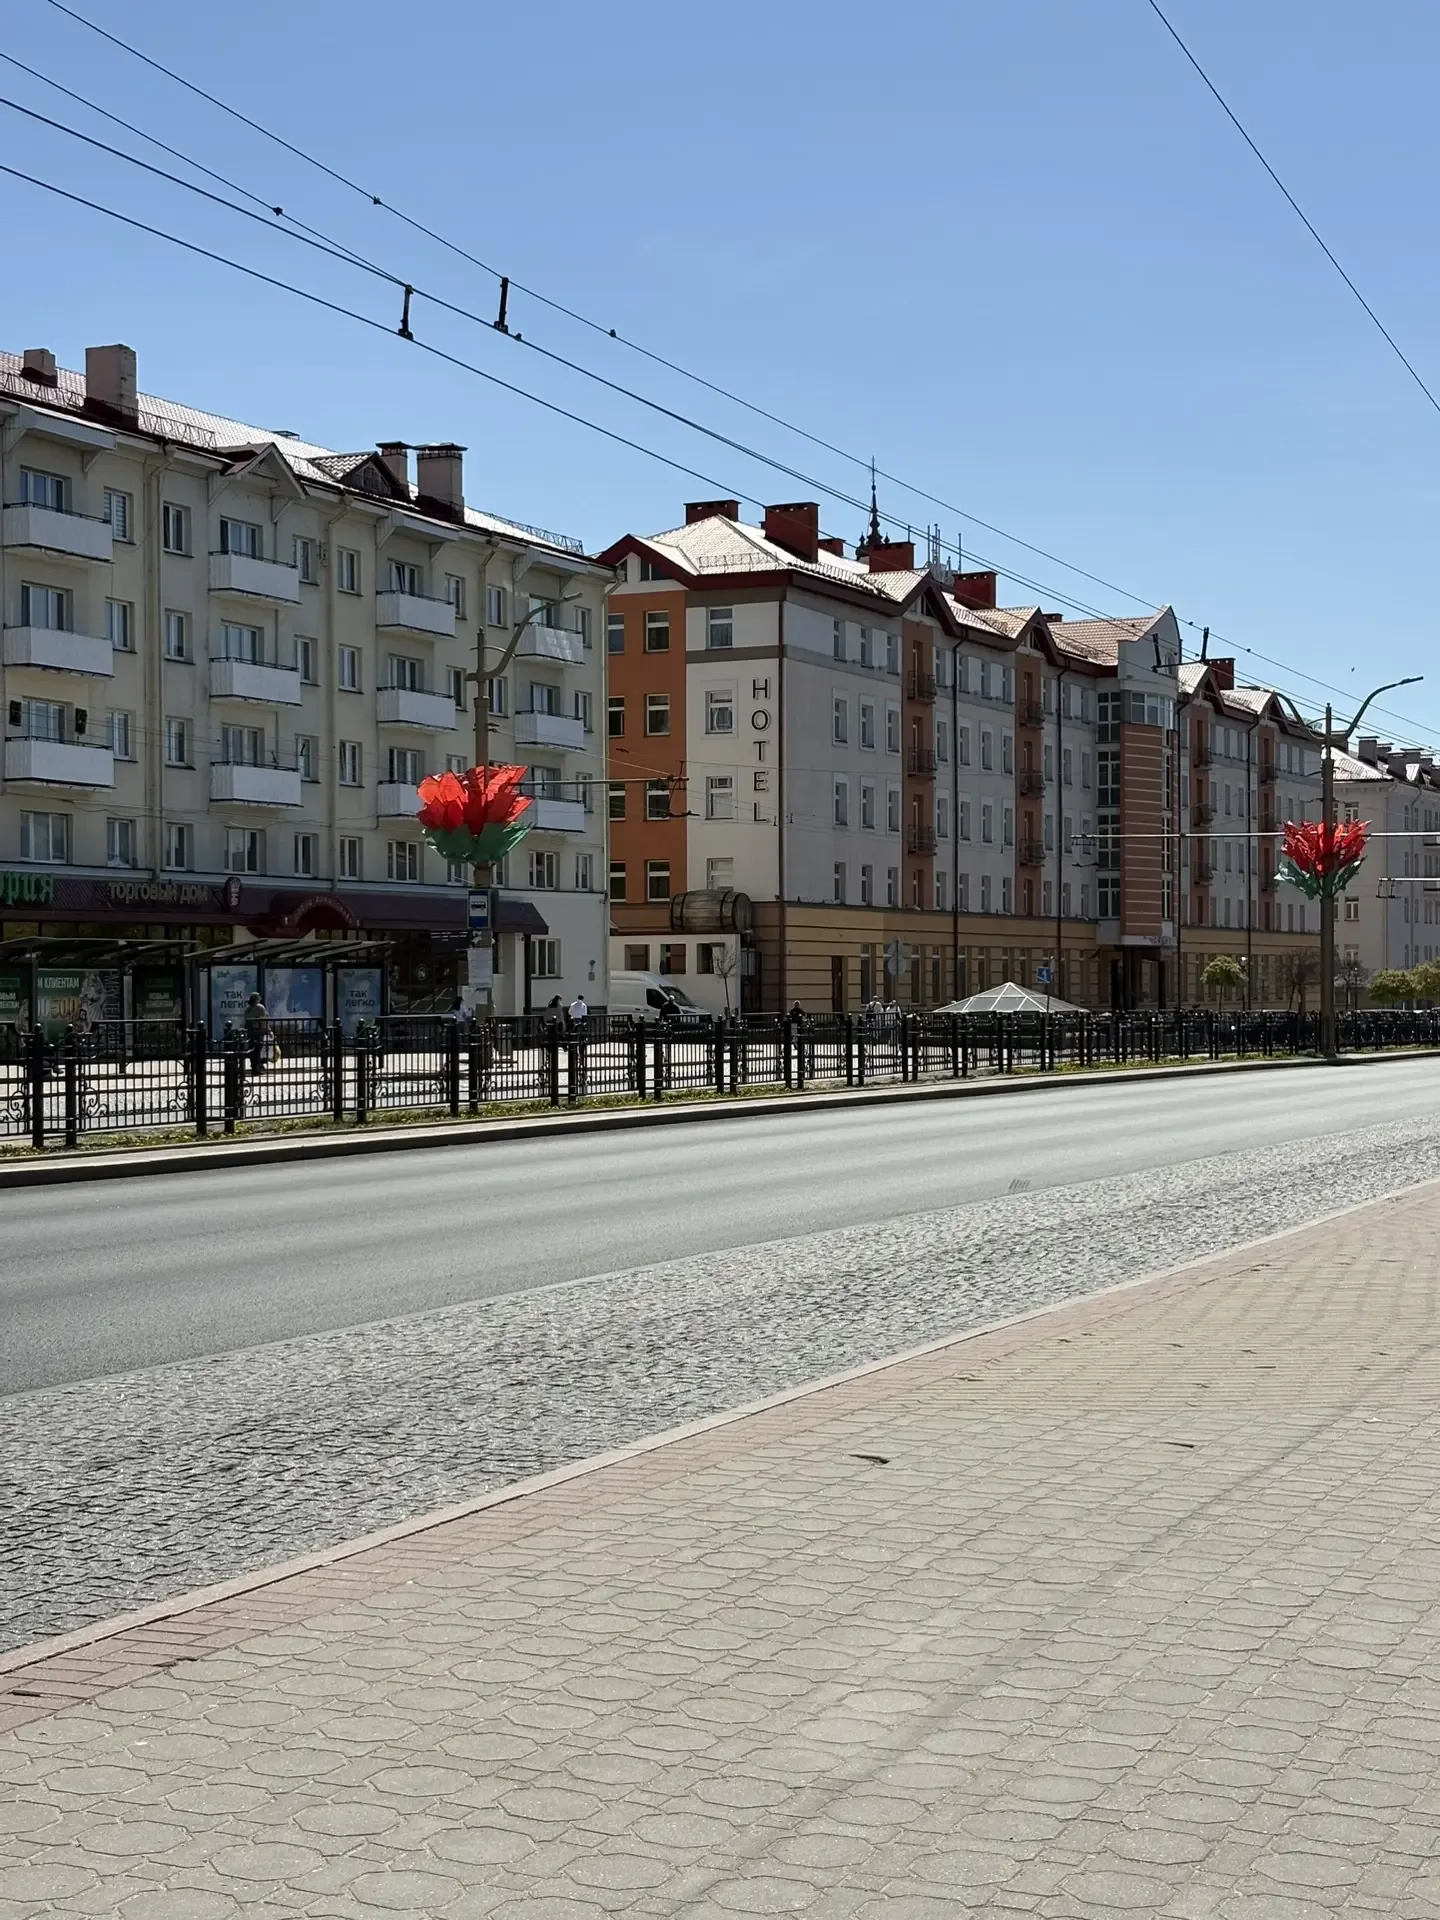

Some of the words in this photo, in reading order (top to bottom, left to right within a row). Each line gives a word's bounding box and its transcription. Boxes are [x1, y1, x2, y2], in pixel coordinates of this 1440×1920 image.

[751, 678, 769, 822] HOTEL
[44, 977, 79, 989] КЛИЕНТАМ
[348, 990, 368, 998] так
[345, 998, 375, 1008] легко
